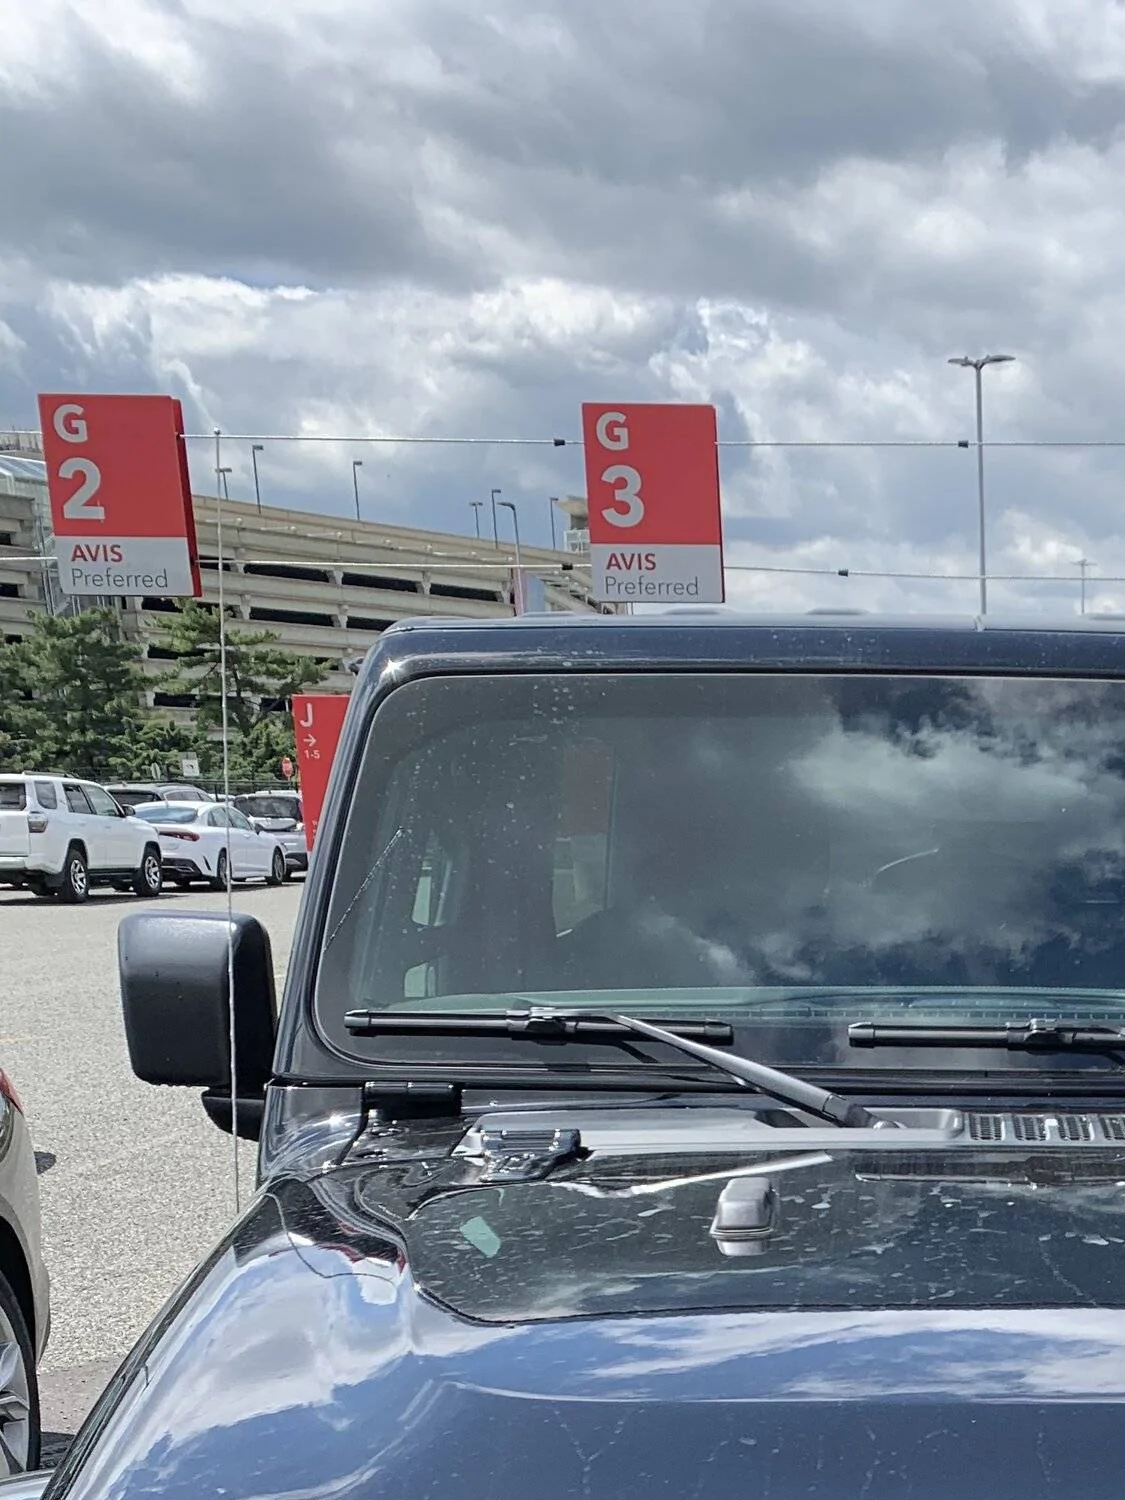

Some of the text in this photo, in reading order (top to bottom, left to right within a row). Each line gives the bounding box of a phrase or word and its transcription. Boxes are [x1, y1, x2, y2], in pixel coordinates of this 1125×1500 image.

[53, 403, 88, 443] G
[596, 411, 629, 451] G
[58, 457, 105, 520] 2
[601, 464, 645, 528] 3
[71, 544, 123, 563] AVIS
[606, 553, 657, 571] AVIS
[71, 567, 169, 588] Preferred
[604, 575, 699, 596] Preferred
[299, 702, 313, 727] J
[303, 749, 320, 759] 1-5
